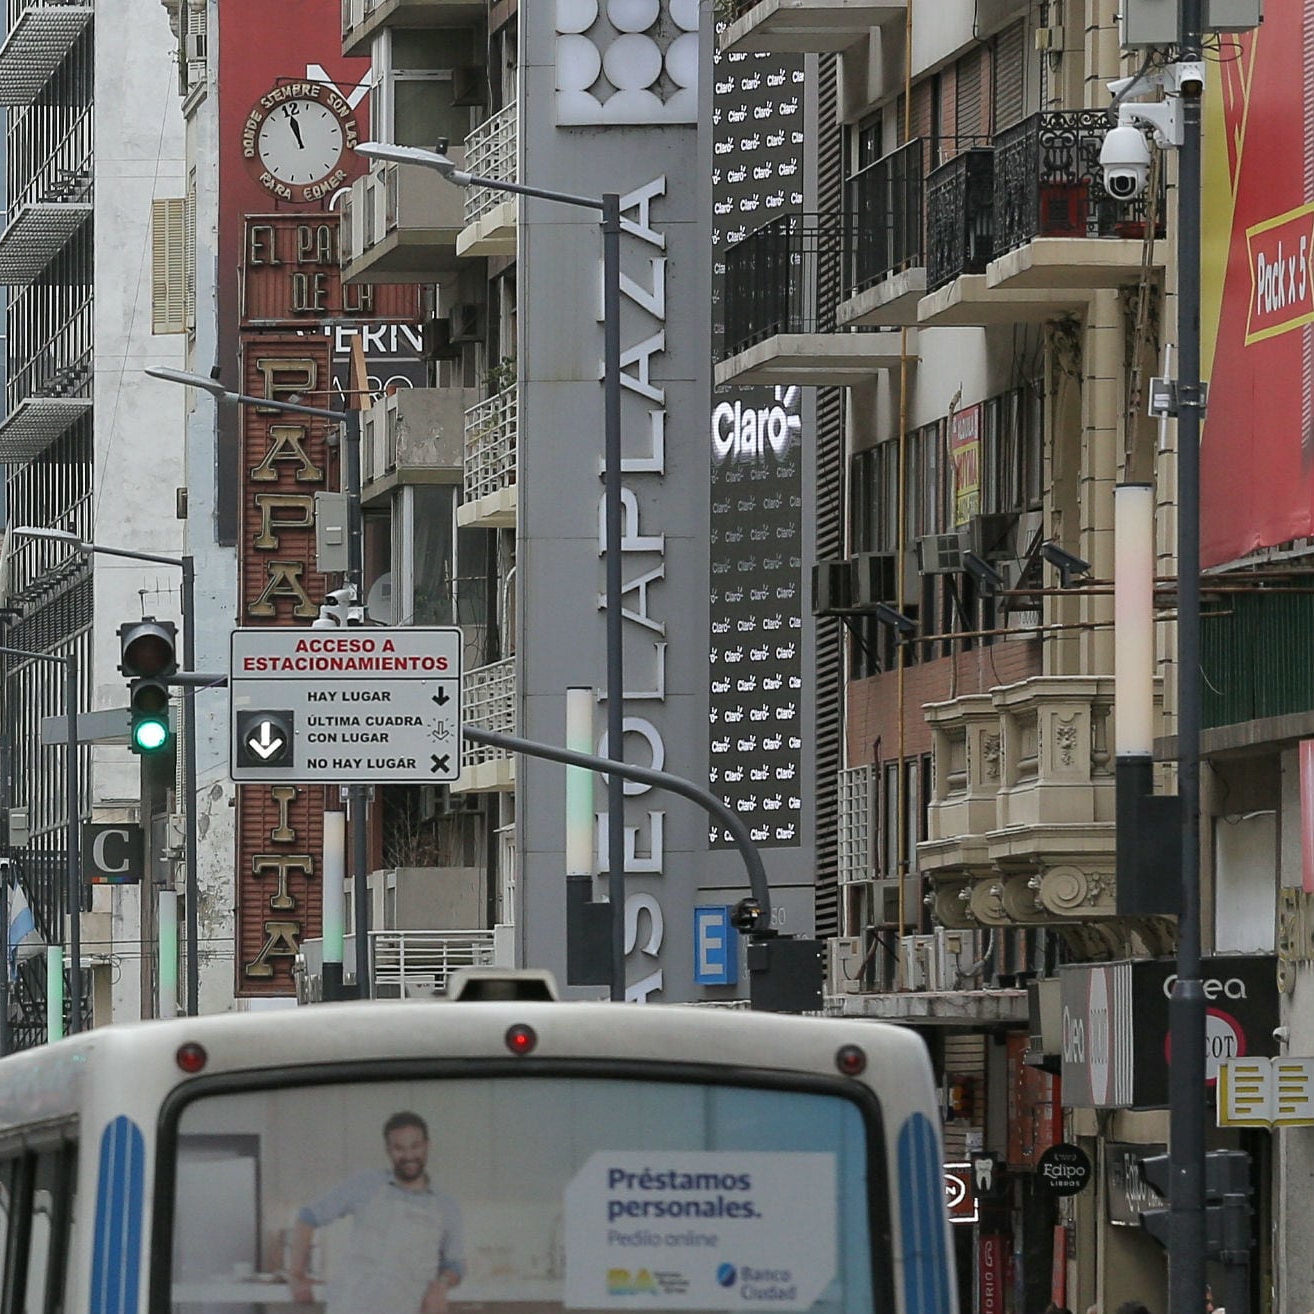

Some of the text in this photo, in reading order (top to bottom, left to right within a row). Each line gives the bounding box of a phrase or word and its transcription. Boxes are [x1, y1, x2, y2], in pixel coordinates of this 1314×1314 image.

[280, 101, 298, 119] 12
[728, 101, 797, 123] Claro Claro Claro
[243, 109, 263, 158] DONDE
[326, 92, 350, 119] SON
[345, 119, 358, 150] LAS
[259, 171, 292, 201] PARA
[250, 225, 281, 266] EL
[1257, 235, 1308, 316] Pack x 5
[293, 272, 327, 313] DE
[711, 395, 796, 460] Claro
[295, 639, 395, 653] ACCESO A
[243, 657, 449, 671] ESTACIONAMIENTOS
[308, 691, 391, 702] HAY LUGAR
[308, 714, 423, 726] ÚLTIMA CUADRA
[725, 705, 795, 722] Claro Claro Claro
[308, 733, 389, 743] CON LUGAR
[308, 758, 416, 769] NO HAY LUGAR
[699, 914, 723, 975] E
[607, 1167, 752, 1192] Préstamos
[1043, 1163, 1086, 1181] Edipo
[607, 1197, 763, 1222] personales.
[740, 1267, 792, 1284] Banco
[740, 1285, 797, 1301] Ciudad
